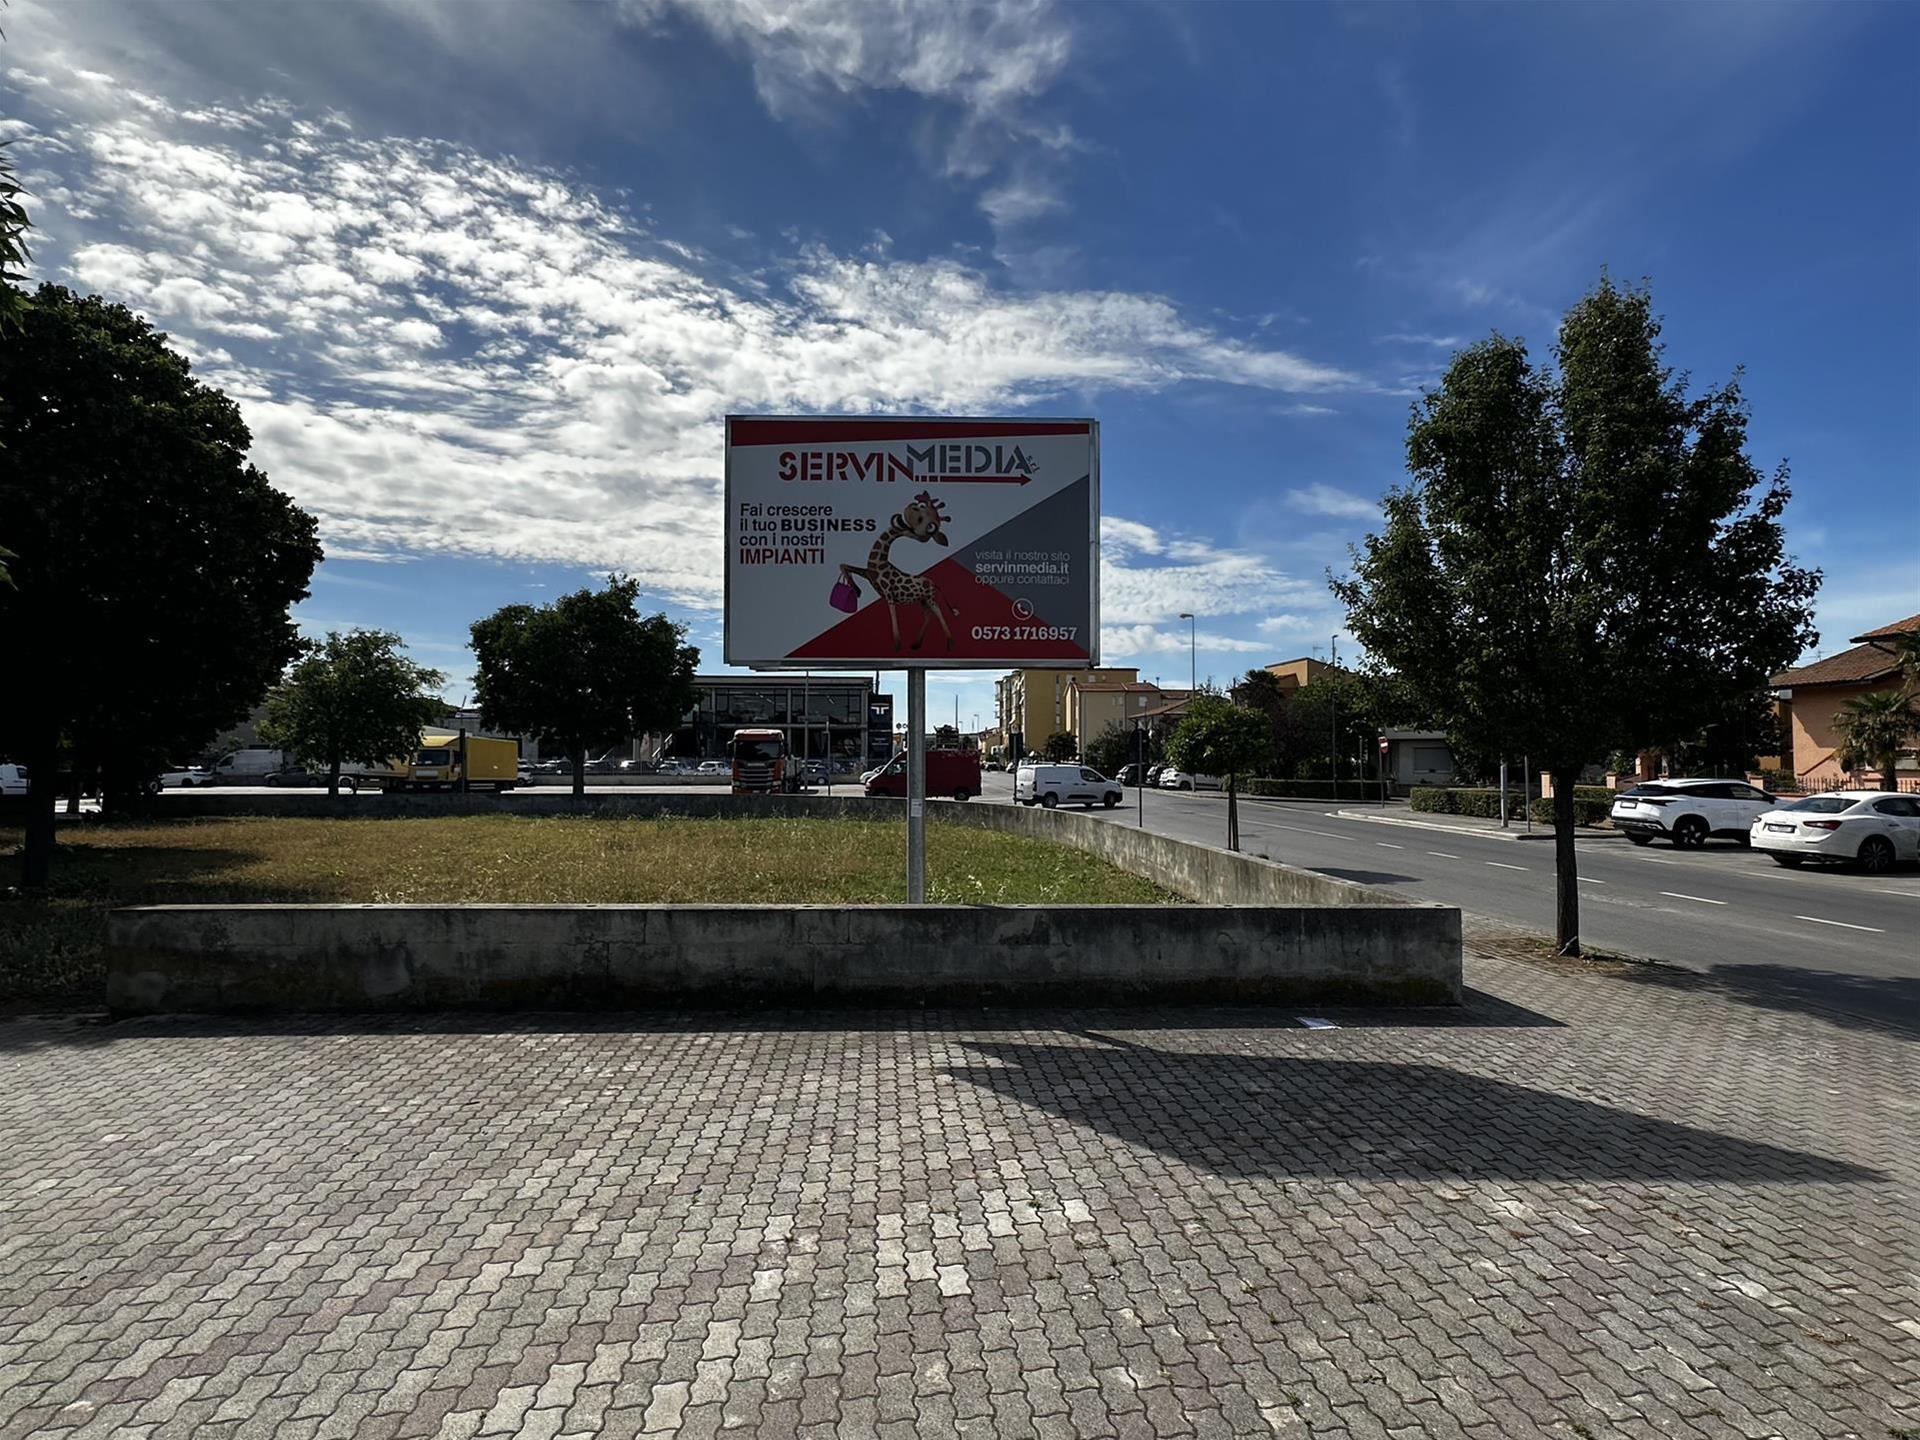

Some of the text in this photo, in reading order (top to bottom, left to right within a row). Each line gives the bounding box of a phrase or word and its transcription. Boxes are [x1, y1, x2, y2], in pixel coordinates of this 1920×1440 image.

[740, 503, 833, 516] Fai crescere
[740, 518, 876, 532] il tuo BUSINESS
[740, 534, 768, 546] con
[781, 533, 824, 546] nostri
[740, 548, 824, 564] IMPIANTI
[975, 550, 1070, 561] visita il nostro sito
[975, 561, 1069, 574] servinmedia.it
[975, 574, 1070, 586] oppure contattaci
[971, 626, 1077, 640] 0573 1716957
